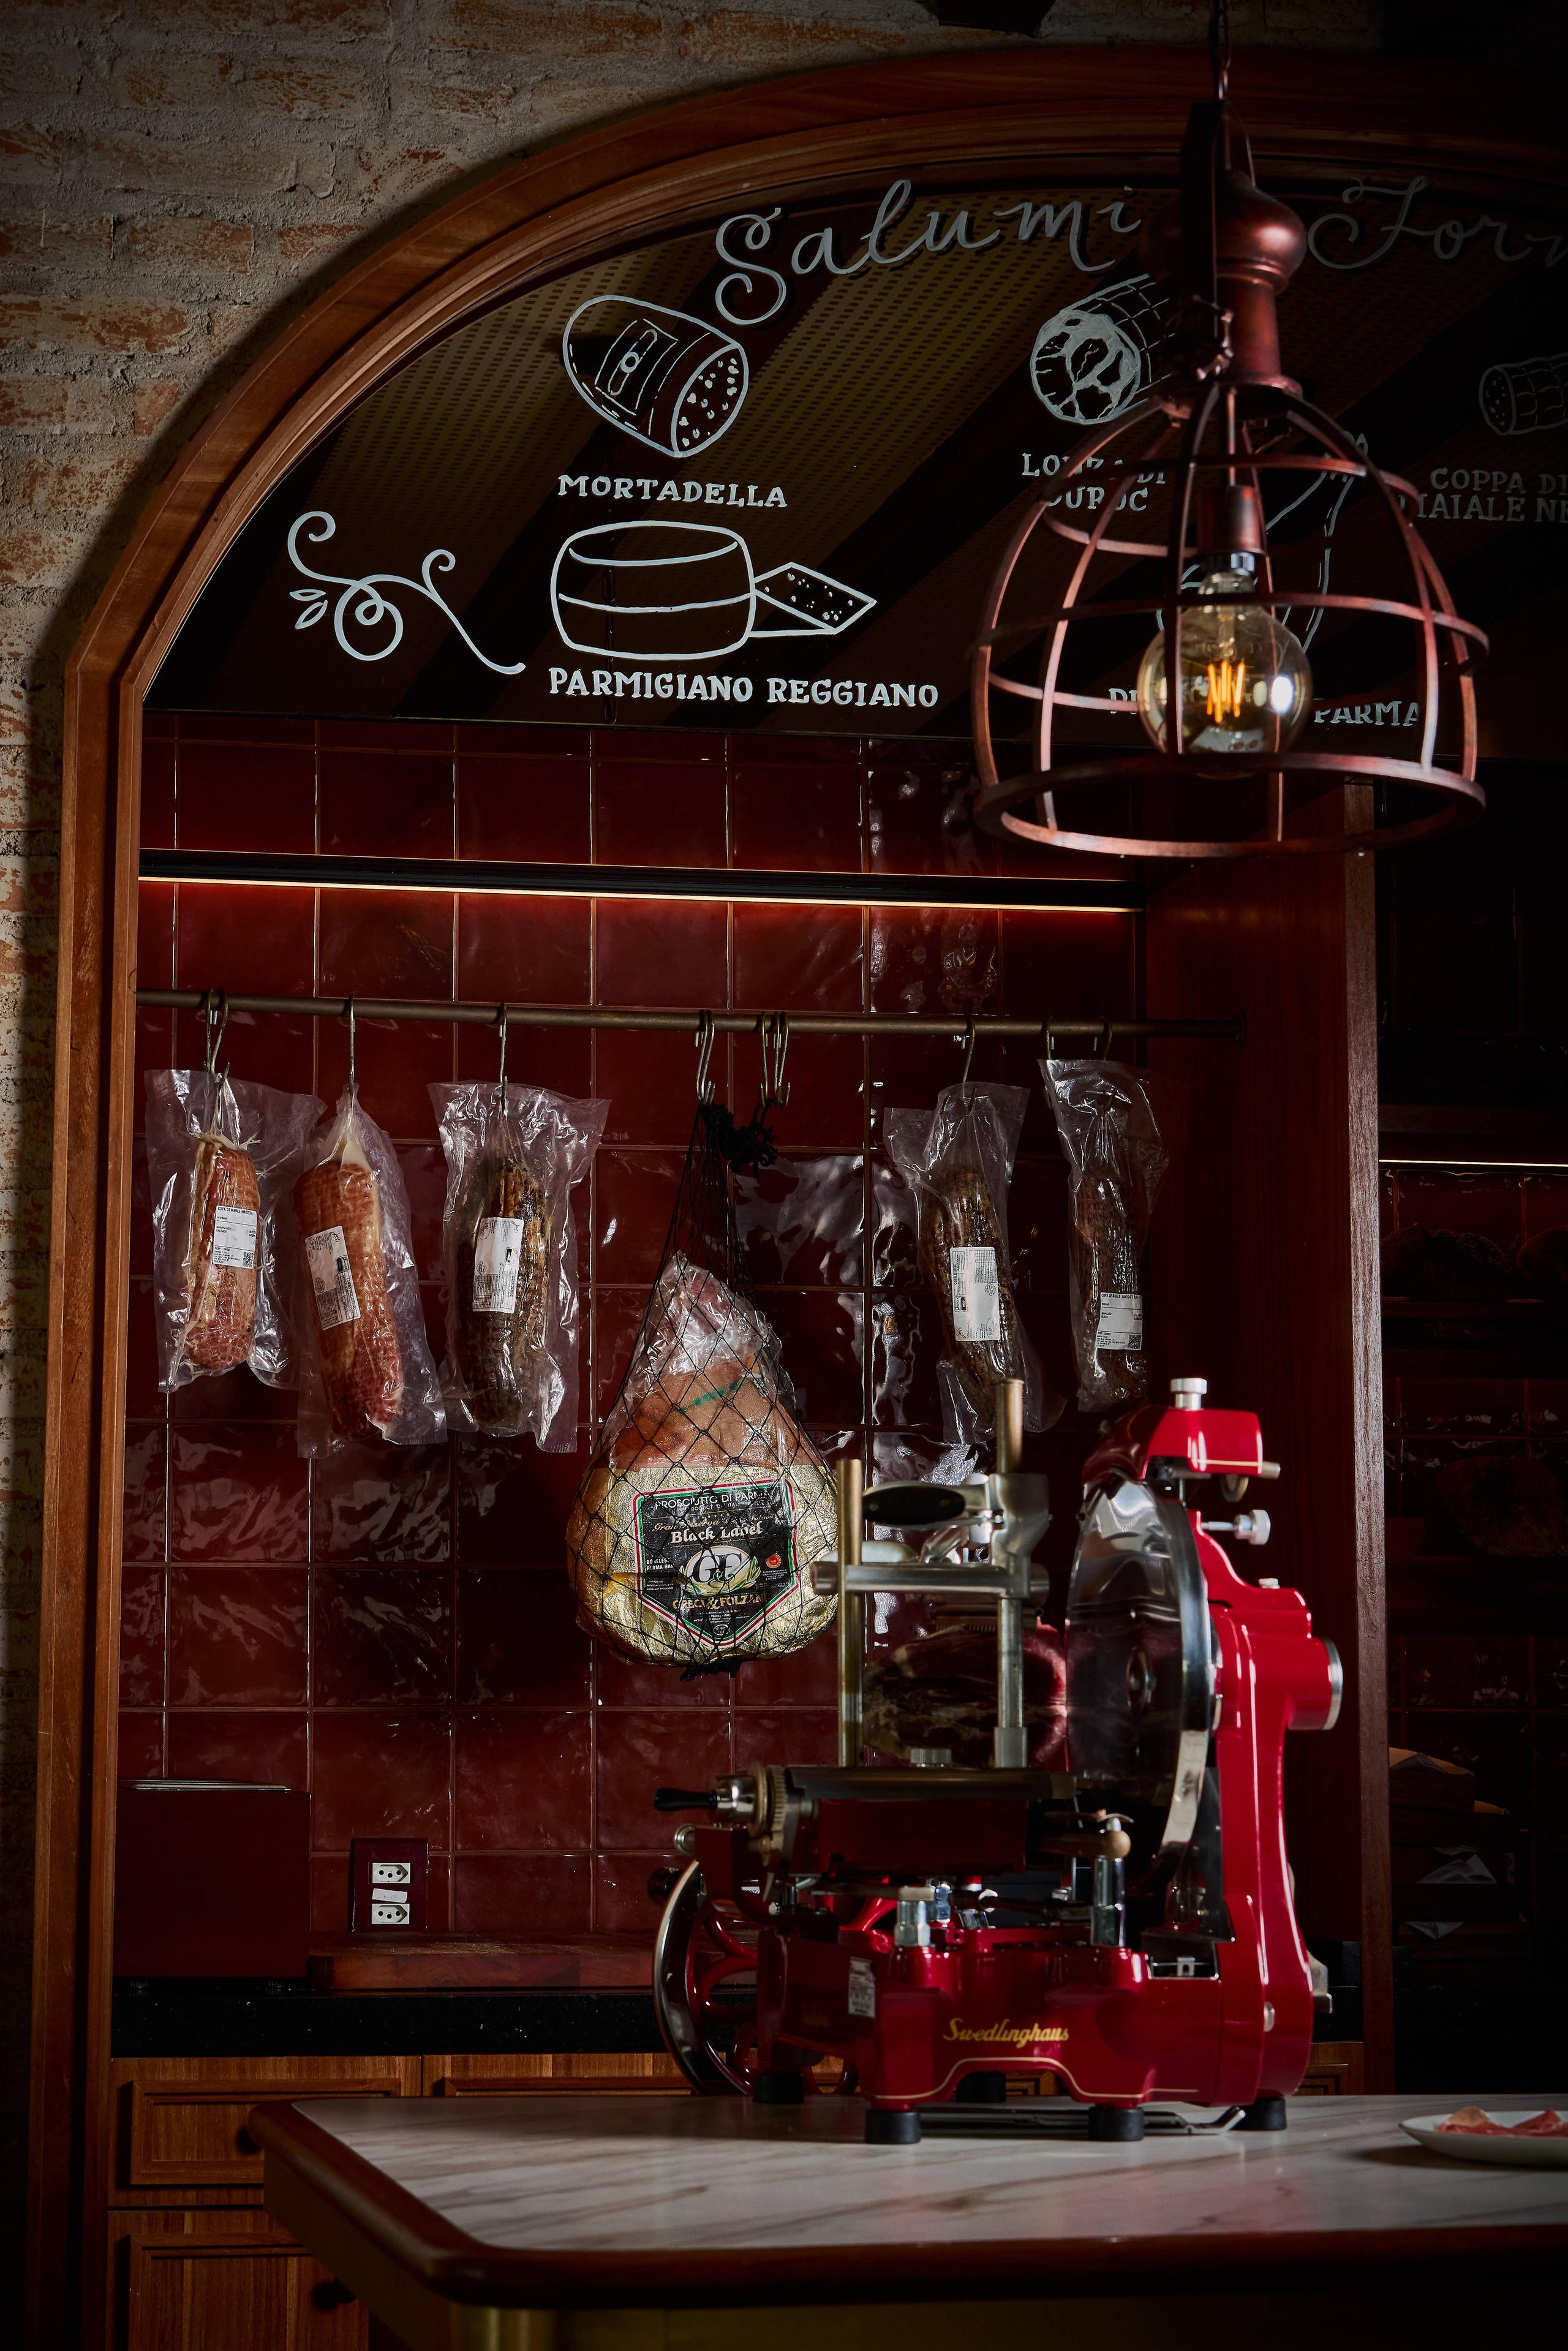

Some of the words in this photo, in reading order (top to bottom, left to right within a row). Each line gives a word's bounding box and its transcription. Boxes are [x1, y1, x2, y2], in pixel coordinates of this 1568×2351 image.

[715, 179, 1141, 325] Salumi
[557, 474, 788, 508] MORTADELLA
[1430, 467, 1526, 494] COPPA
[1538, 473, 1568, 496] DI
[549, 667, 753, 703] PARMIGIANO
[766, 677, 938, 708] REGGIANO
[735, 1489, 772, 1501] PAR
[670, 1526, 716, 1544] Black
[942, 2017, 1070, 2049] Swedlinghaus
